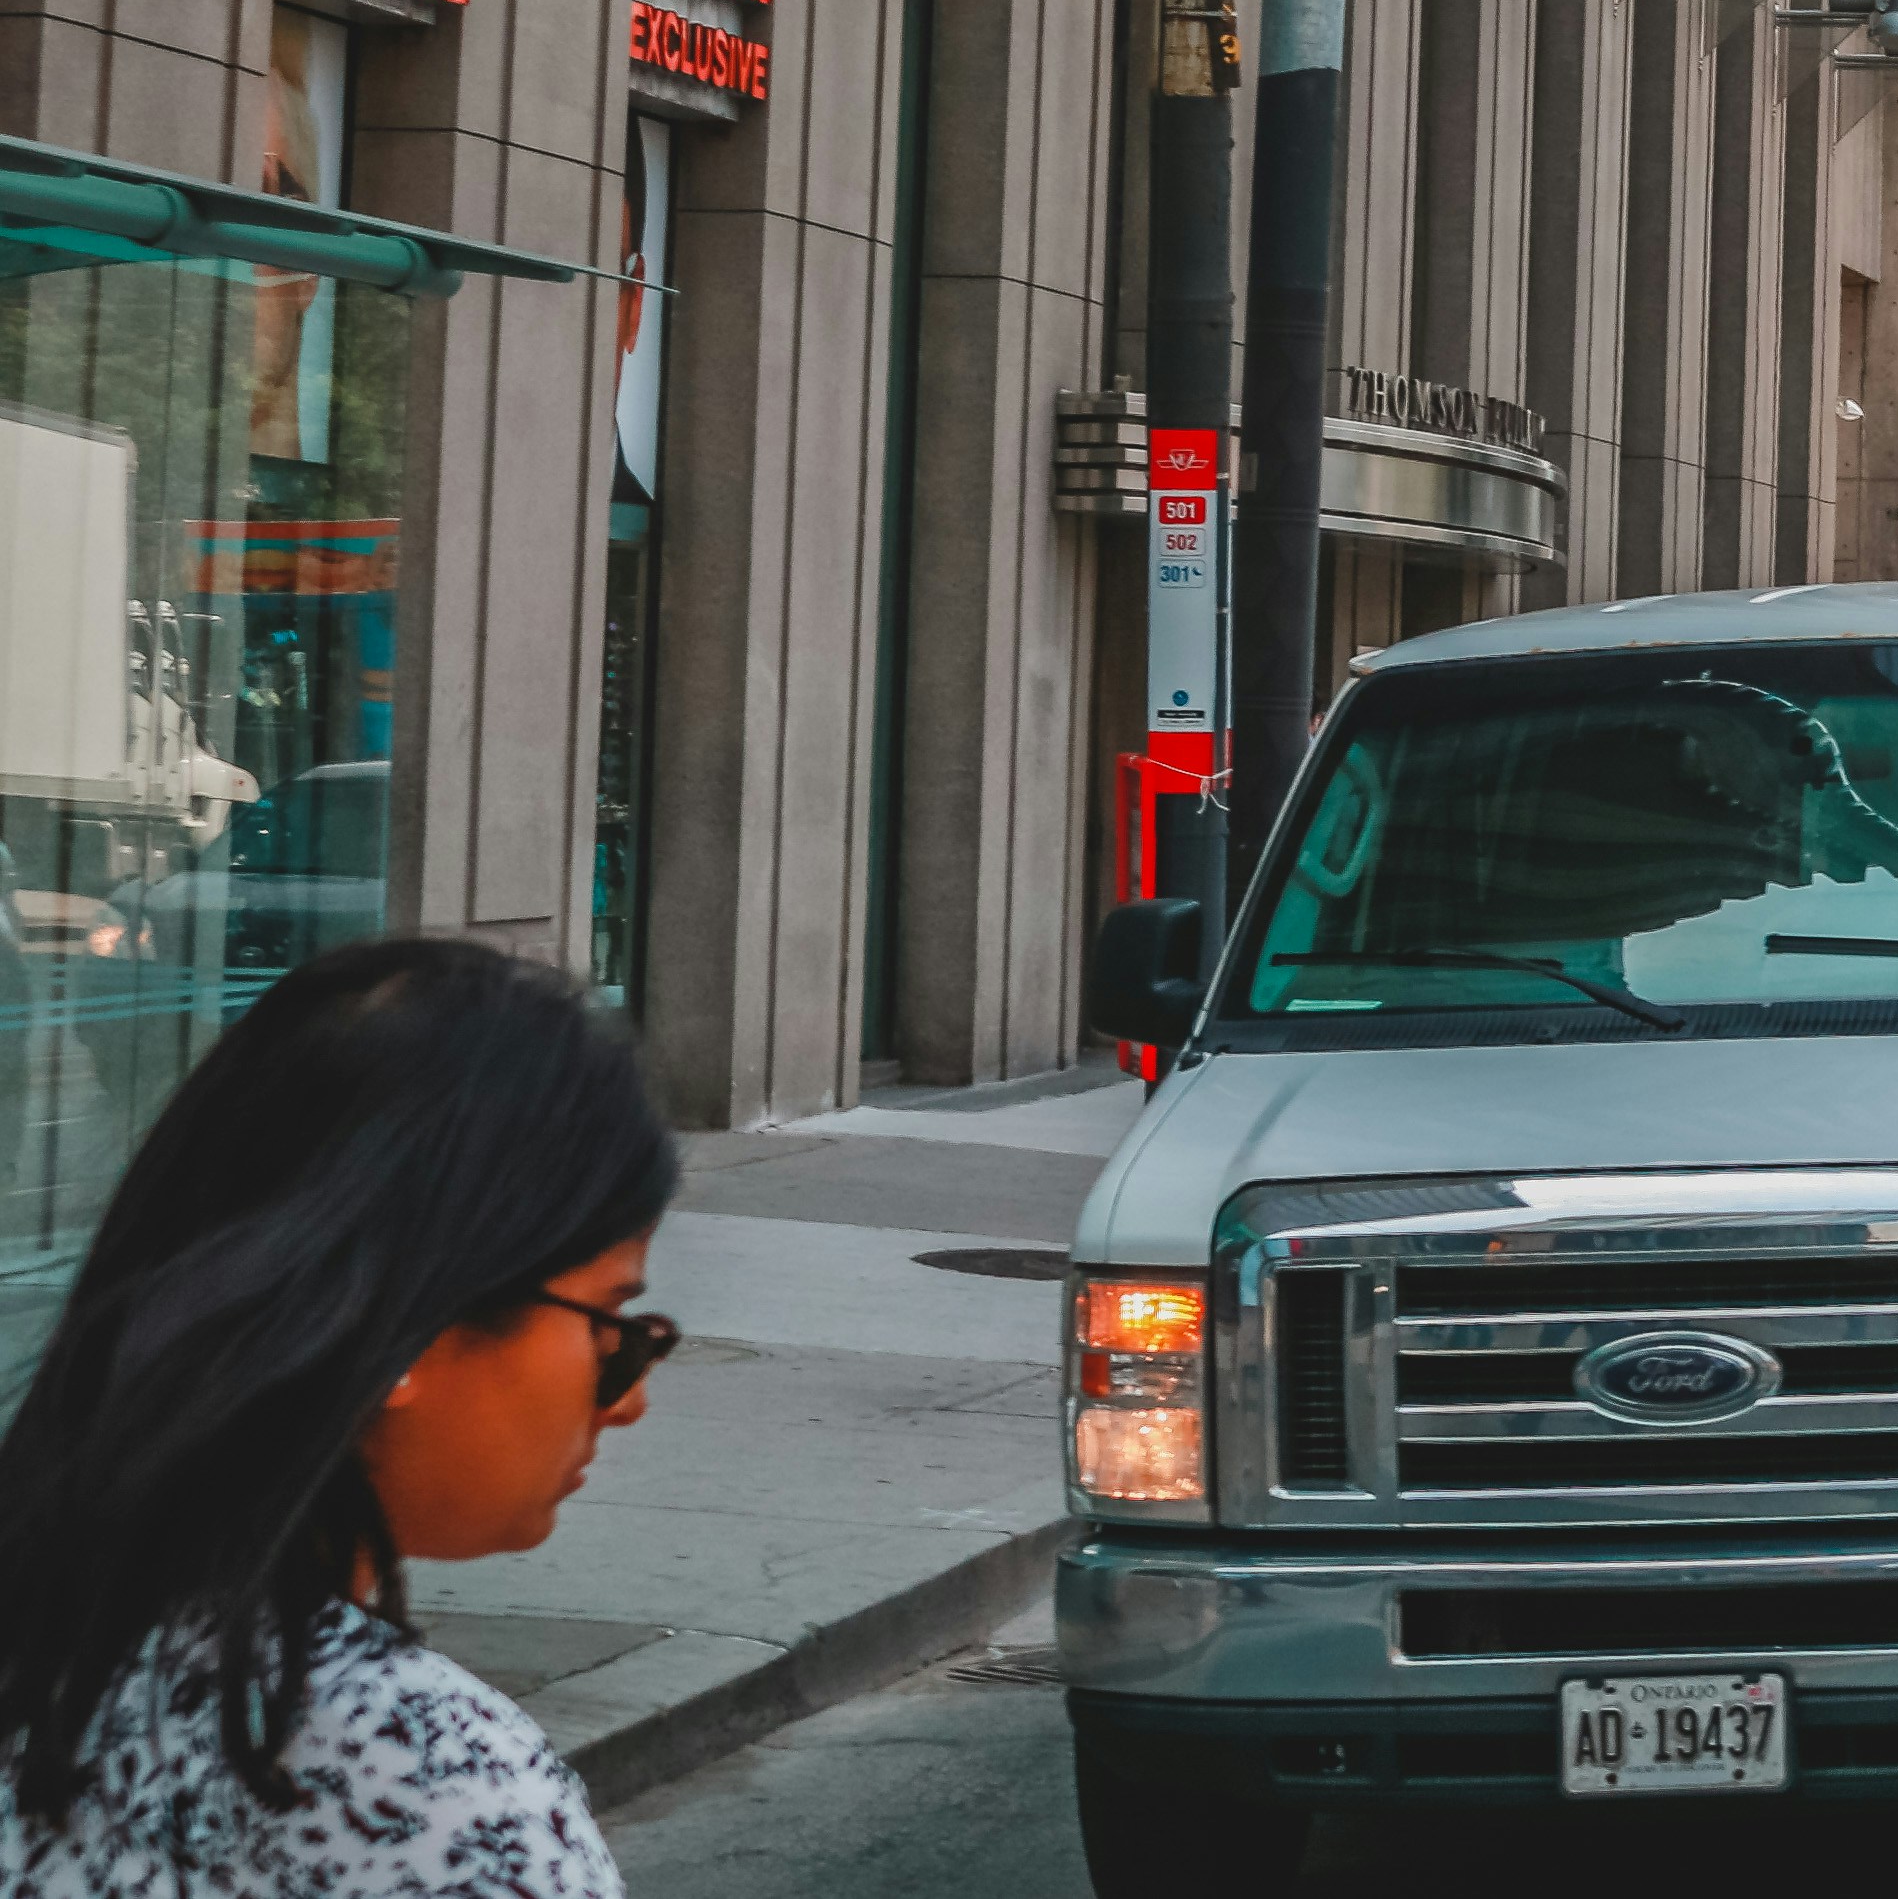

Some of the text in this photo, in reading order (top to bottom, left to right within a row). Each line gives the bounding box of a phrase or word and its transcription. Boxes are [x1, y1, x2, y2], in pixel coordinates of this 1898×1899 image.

[629, 0, 770, 101] EXCLUSIVE
[1165, 502, 1196, 519] 501
[1165, 534, 1197, 550] 502
[1160, 565, 1190, 582] 301
[1628, 1356, 1720, 1393] Ford
[1630, 1683, 1719, 1702] ONTARIO
[1574, 1703, 1775, 1766] AD 19437
